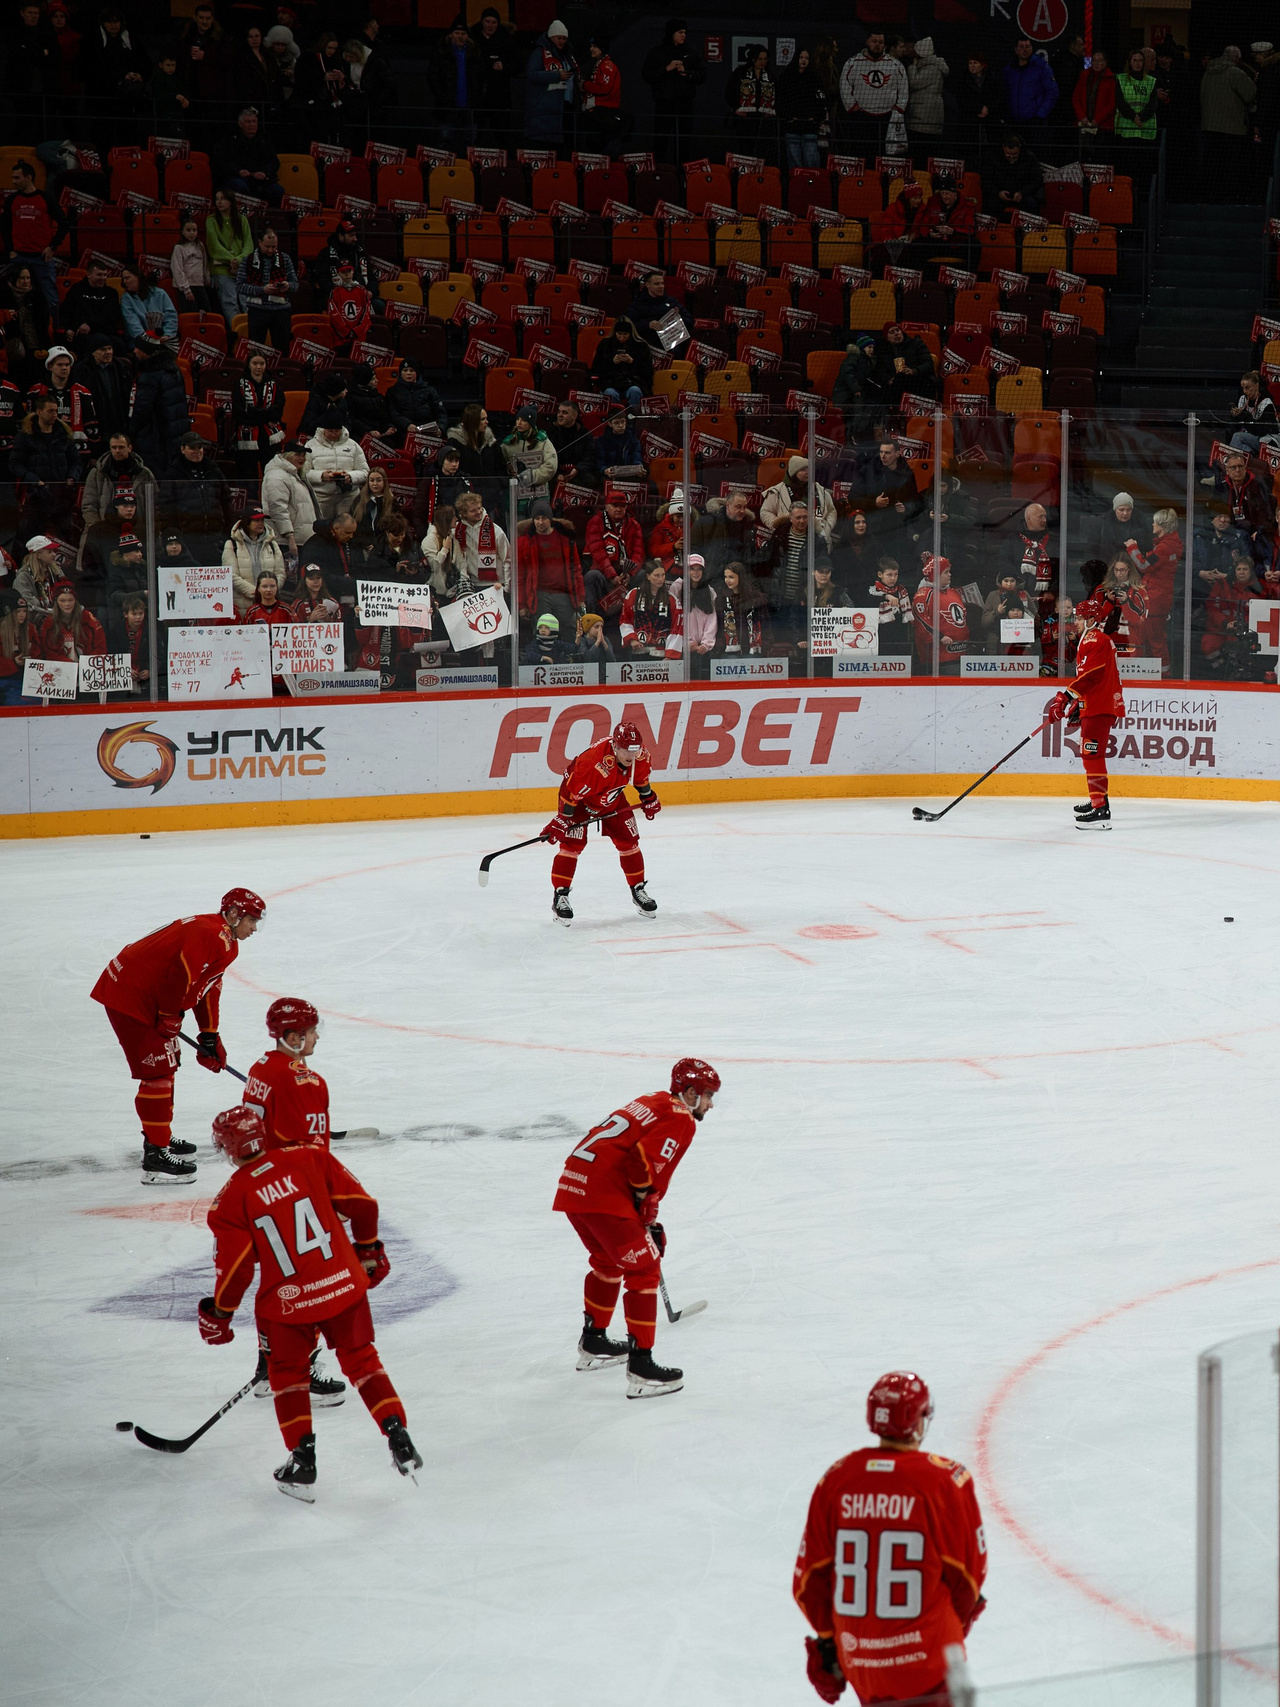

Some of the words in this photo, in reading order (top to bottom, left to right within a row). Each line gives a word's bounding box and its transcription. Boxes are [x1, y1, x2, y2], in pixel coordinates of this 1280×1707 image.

[360, 583, 405, 595] НИКИТА
[462, 592, 485, 609] АВТО
[364, 609, 388, 618] ВОИН
[811, 616, 852, 625] ПРЕКРАСЕН
[813, 608, 833, 617] МИР
[272, 626, 288, 638] 77
[291, 624, 340, 640] СТЕФАН
[272, 640, 288, 649] ДА
[292, 640, 318, 649] КОСТА
[169, 651, 213, 660] ПРОДОЛЖАЙ
[279, 650, 315, 659] МОЖНО
[199, 659, 211, 667] ЖЕ
[291, 657, 334, 673] ШАЙБУ
[715, 664, 784, 676] SIMA-LAND
[838, 661, 907, 673] SIMA-LAND
[965, 661, 1034, 673] SIMA-LAND
[321, 679, 379, 689] УРАЛМАШЗАВОД
[440, 674, 497, 684] УРАЛМАШЗАВОД
[550, 676, 584, 686] ЗАВОД
[636, 673, 670, 683] ЗАВОД
[36, 686, 75, 699] АЛИКИН
[1127, 699, 1218, 715] ДИНСКИЙ
[1110, 716, 1217, 732] ИРПИЧНЫЙ
[187, 726, 327, 756] УГМК
[489, 696, 862, 779] FONBET
[1105, 735, 1216, 768] ЗАВОД
[187, 753, 326, 781] UMMC
[306, 1112, 327, 1135] 28
[572, 1113, 630, 1163] 2
[256, 1174, 299, 1206] VALK
[253, 1196, 334, 1279] 14
[302, 1268, 352, 1294] УРАЛМАШЗАВОД
[295, 1291, 336, 1309] СВЕРДЛОВСКАЯ
[335, 1283, 356, 1299] ОБЛАСТЬ
[875, 1406, 890, 1425] 86
[841, 1492, 916, 1521] SHAROV
[834, 1528, 925, 1620] 86
